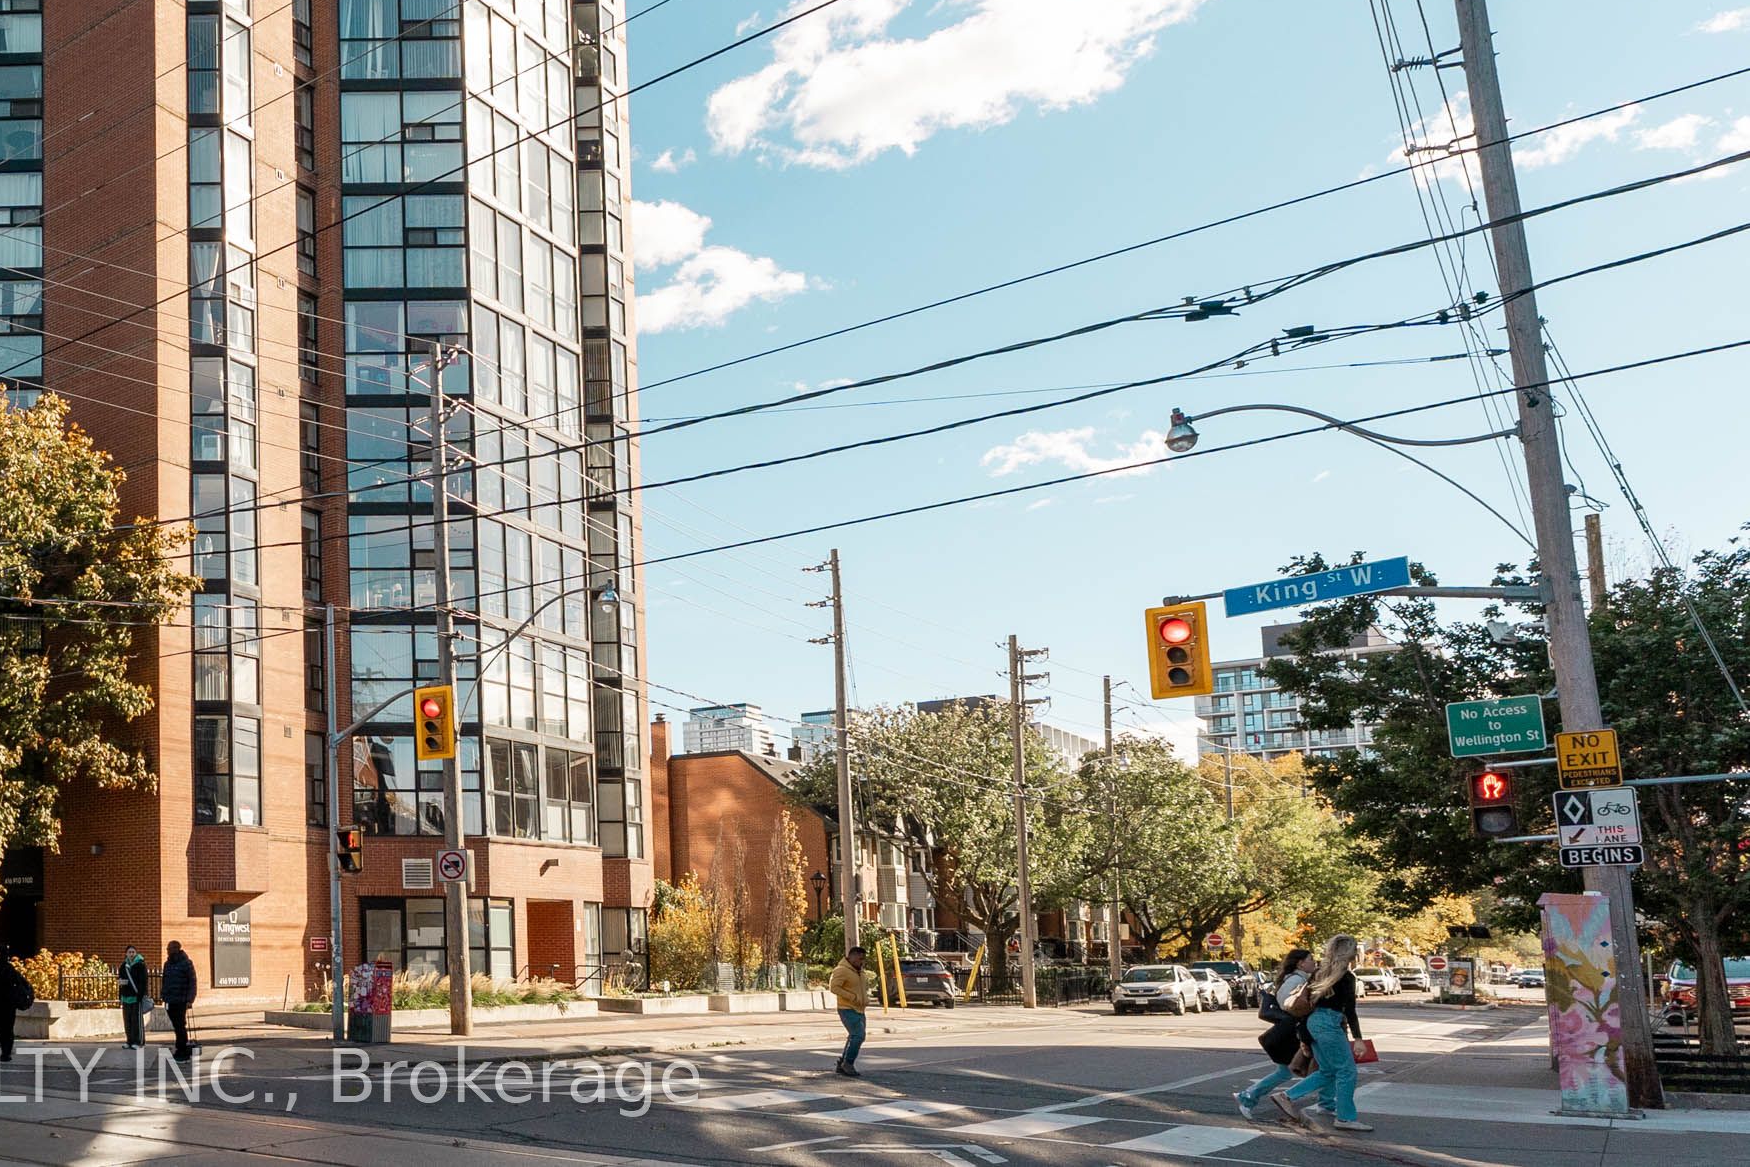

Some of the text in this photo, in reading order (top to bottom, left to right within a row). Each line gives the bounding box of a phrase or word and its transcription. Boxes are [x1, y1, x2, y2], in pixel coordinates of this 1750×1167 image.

[1256, 566, 1371, 604] King St W
[1460, 705, 1528, 720] No Access
[1488, 721, 1502, 730] to
[1455, 729, 1540, 746] Wellington St
[1571, 734, 1600, 749] NO
[1566, 751, 1610, 767] EXIT
[1563, 768, 1618, 779] PEDESTRIANS
[1597, 825, 1625, 834] THIS
[1595, 834, 1628, 843] LANE
[1568, 848, 1635, 864] BEGINS
[217, 920, 250, 935] Kingwest
